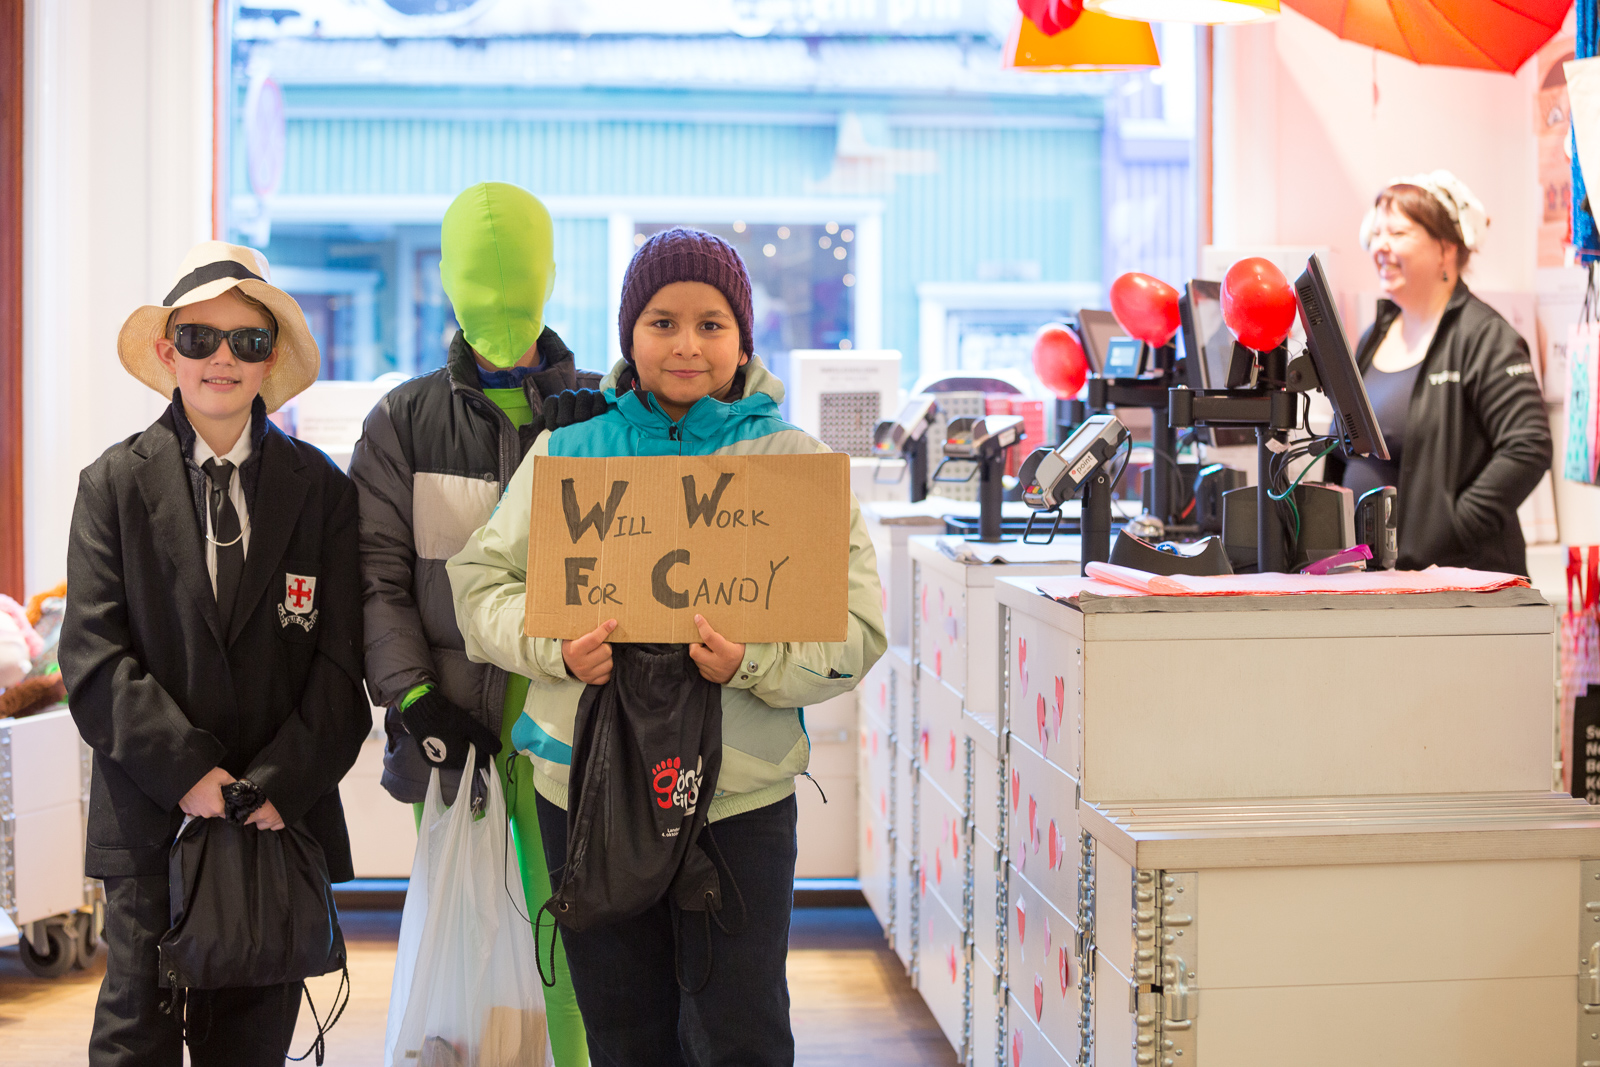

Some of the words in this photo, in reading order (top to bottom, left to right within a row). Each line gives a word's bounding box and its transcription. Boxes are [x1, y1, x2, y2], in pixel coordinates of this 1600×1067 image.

[1076, 455, 1093, 475] point
[561, 478, 652, 544] WILL
[682, 472, 770, 528] WORK
[564, 557, 623, 605] FOR
[651, 549, 789, 610] CANDY
